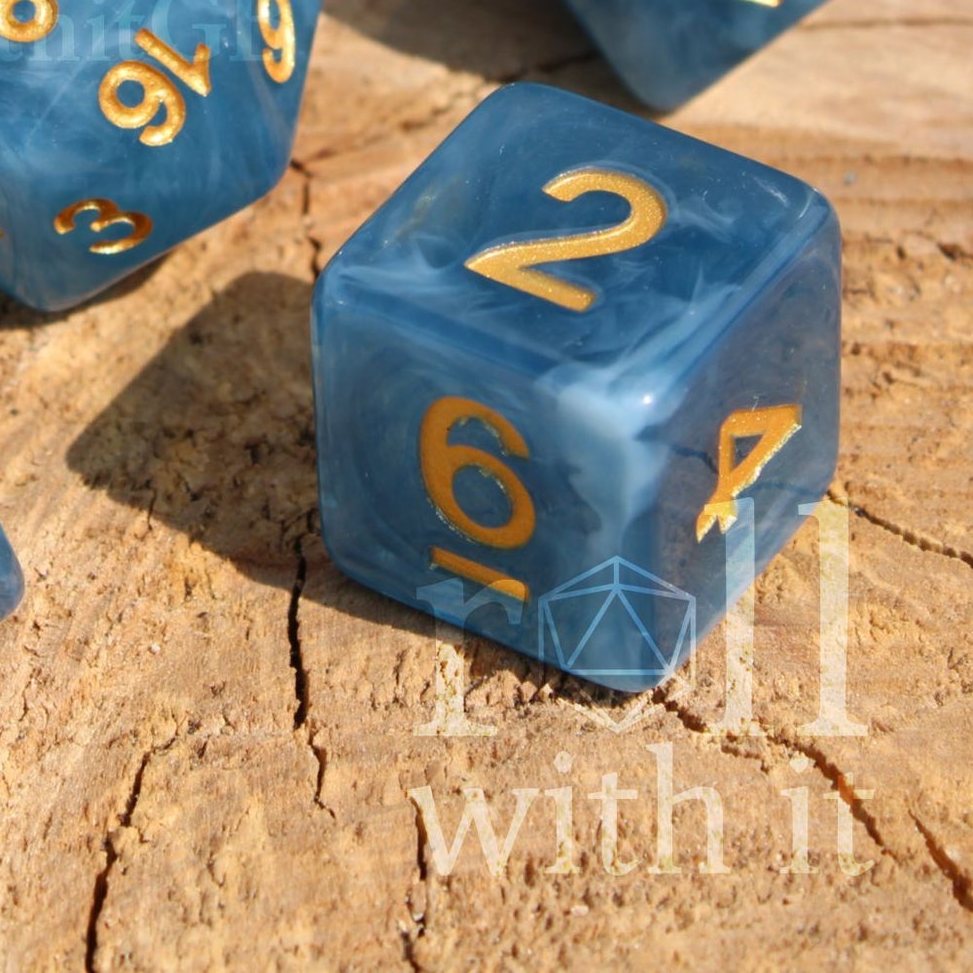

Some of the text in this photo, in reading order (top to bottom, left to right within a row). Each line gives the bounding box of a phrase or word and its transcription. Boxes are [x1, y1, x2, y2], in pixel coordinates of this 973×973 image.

[98, 27, 213, 148] 16
[53, 197, 154, 256] 3
[464, 167, 668, 313] 2
[694, 403, 803, 544] 4
